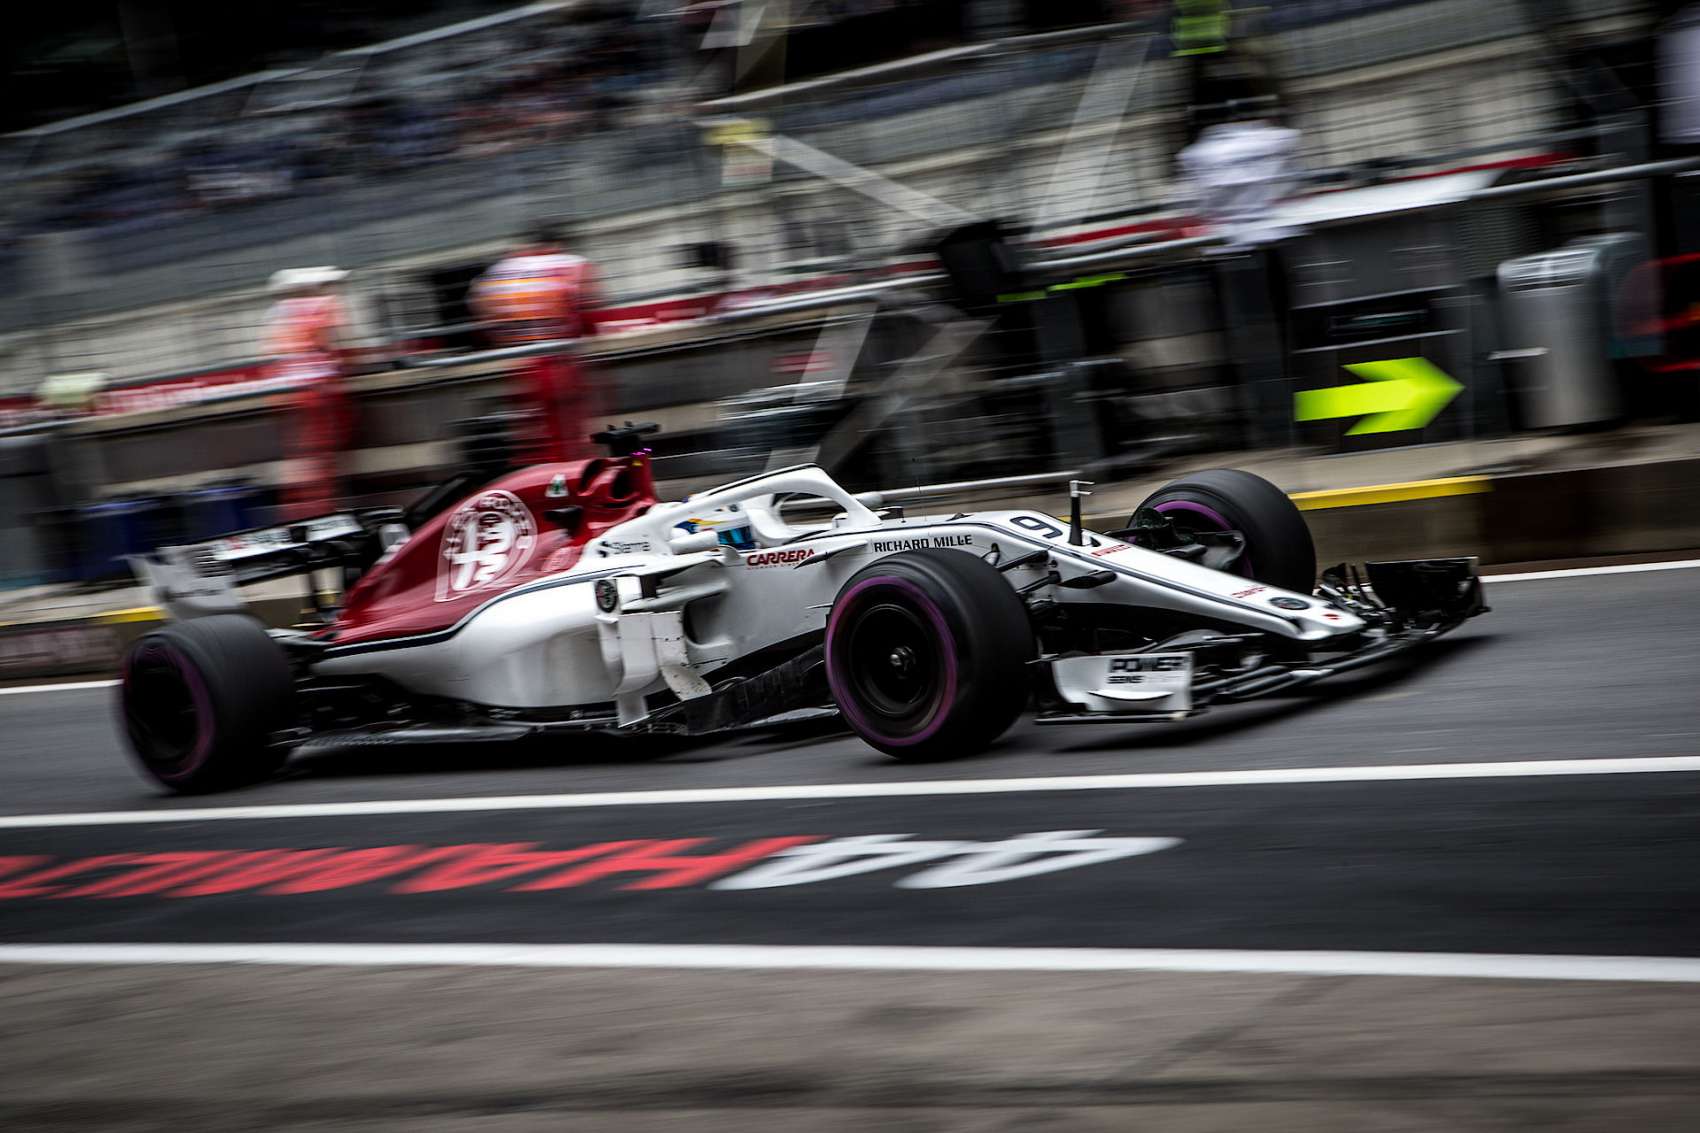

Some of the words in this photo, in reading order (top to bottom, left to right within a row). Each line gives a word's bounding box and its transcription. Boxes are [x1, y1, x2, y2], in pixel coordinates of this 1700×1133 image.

[1009, 515, 1063, 539] 9
[873, 538, 930, 553] RICHARD
[933, 534, 973, 549] MILLE
[746, 548, 815, 566] CARRERA
[709, 829, 1183, 889] 44
